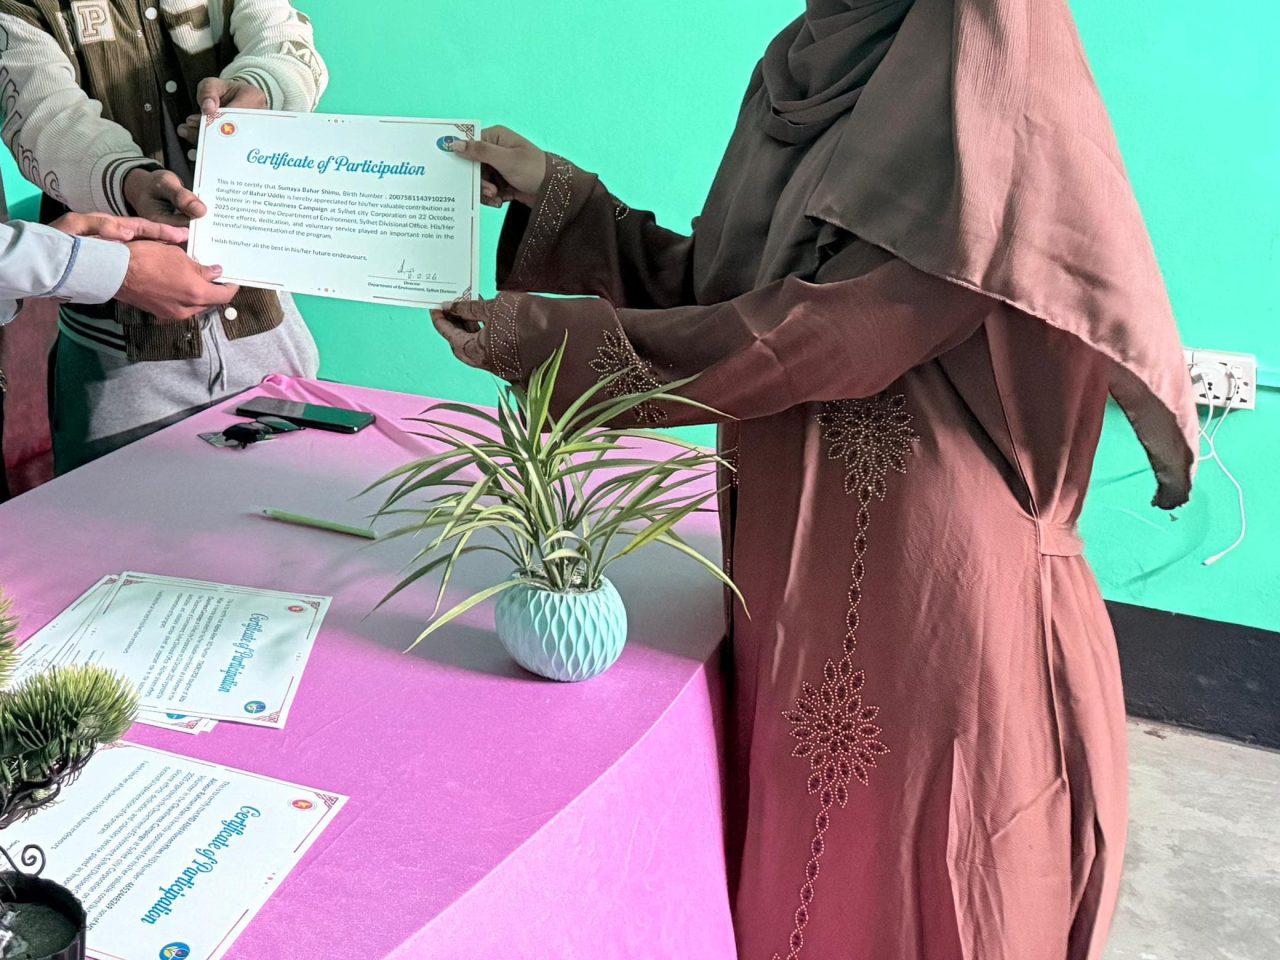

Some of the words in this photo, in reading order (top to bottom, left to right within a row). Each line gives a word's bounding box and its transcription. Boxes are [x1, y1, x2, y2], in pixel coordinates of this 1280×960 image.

[77, 5, 106, 37] P
[245, 147, 316, 171] Certificate
[317, 154, 335, 175] of
[333, 155, 426, 181] Participation
[301, 186, 319, 194] Bahar
[263, 200, 296, 209] Cleanliness
[297, 203, 328, 213] Campaign
[336, 207, 356, 215] Sylhet
[370, 209, 406, 219] Corporation
[240, 612, 269, 643] Certificate
[232, 642, 255, 654] of
[218, 650, 254, 693] Participation
[208, 805, 261, 850] Certificate
[195, 847, 218, 865] of
[140, 859, 213, 925] Participation
